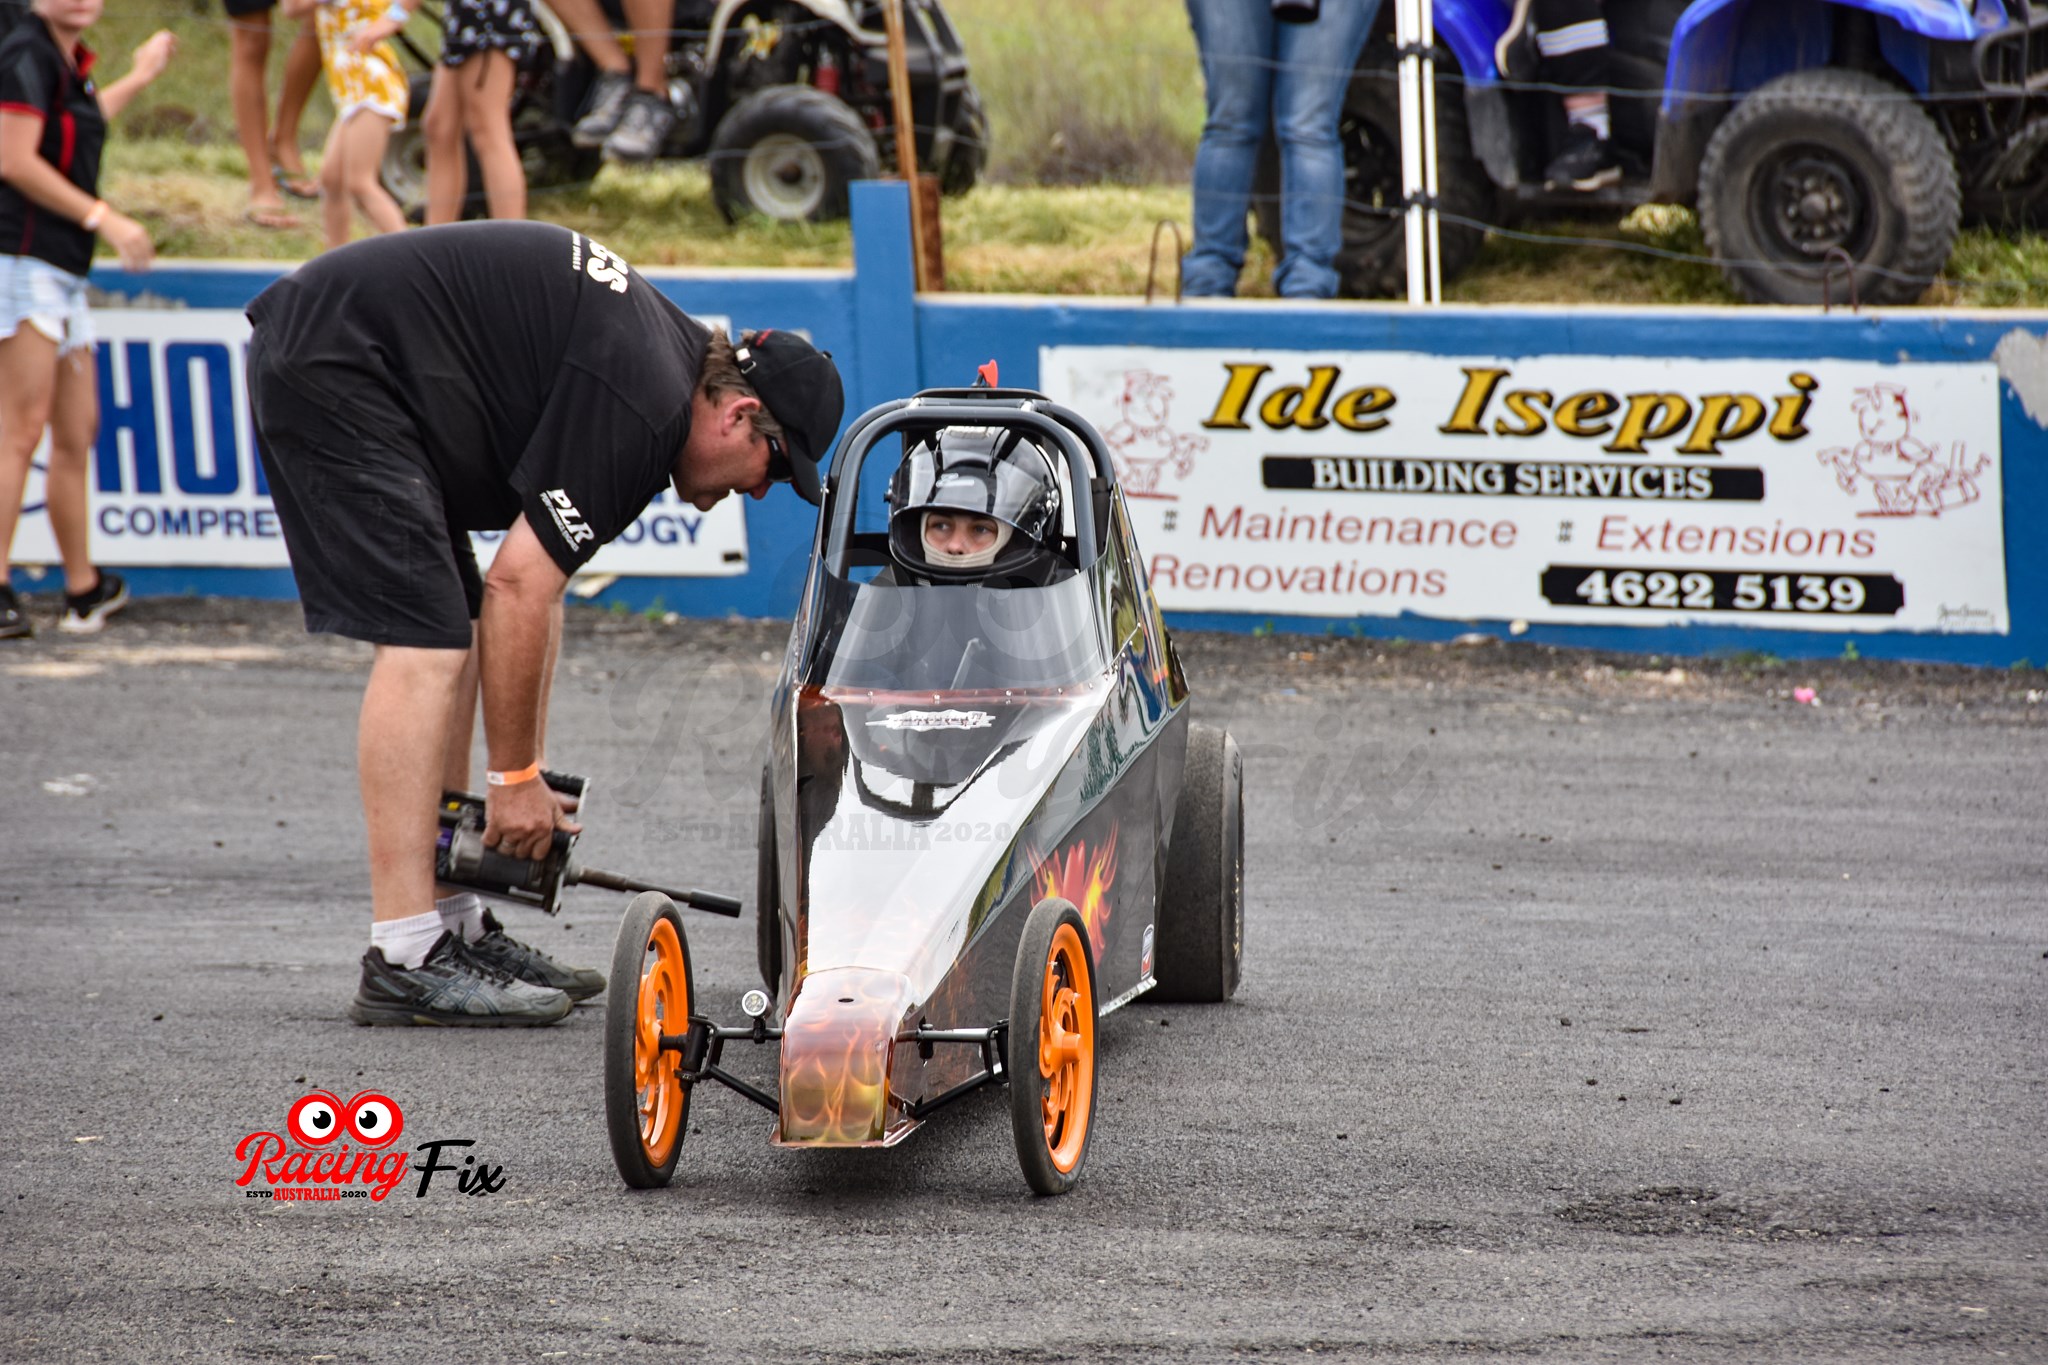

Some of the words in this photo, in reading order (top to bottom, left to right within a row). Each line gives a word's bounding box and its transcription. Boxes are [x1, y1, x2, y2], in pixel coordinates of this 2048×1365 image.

[96, 341, 272, 497] HO
[1201, 362, 1398, 432] Ide
[1438, 366, 1819, 456] Iseppi
[1312, 458, 1504, 494] BUILDING
[1514, 462, 1713, 499] SERVICES
[98, 506, 281, 538] COMPRE
[546, 488, 595, 544] PLR
[1201, 505, 1518, 549] Maintenance
[1596, 514, 1876, 558] Extensions
[1150, 554, 1447, 598] Renovations
[1576, 570, 1715, 608] 4622
[1732, 573, 1866, 612] 5139
